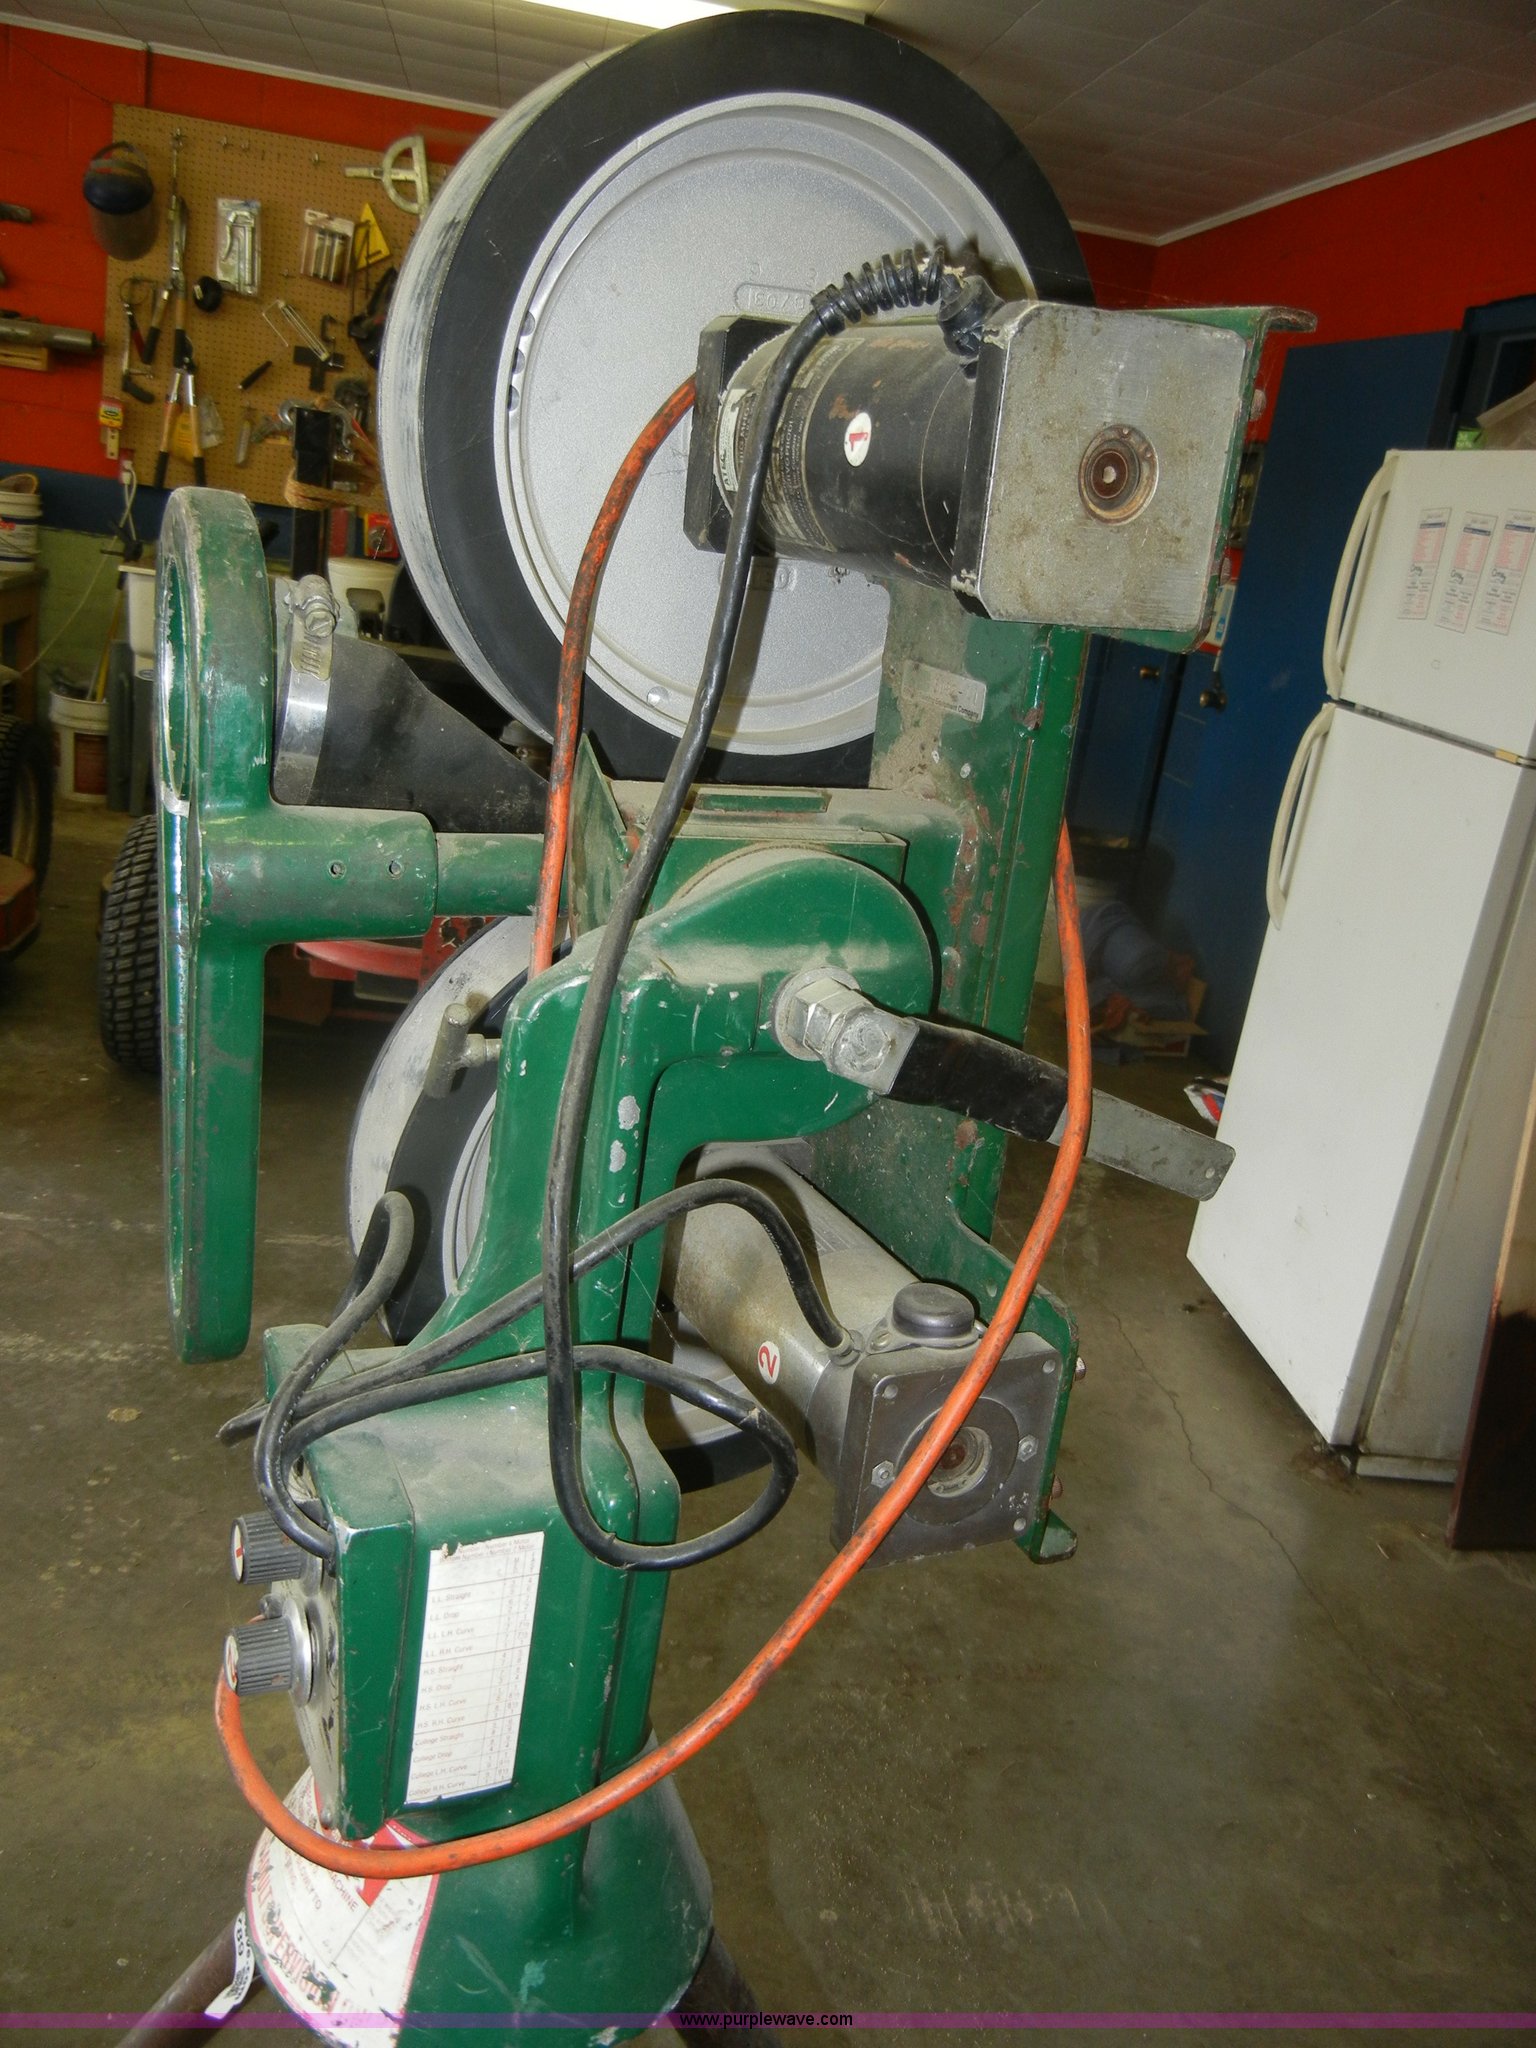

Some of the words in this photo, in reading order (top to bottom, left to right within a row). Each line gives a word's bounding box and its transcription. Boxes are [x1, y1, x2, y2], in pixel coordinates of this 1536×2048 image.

[759, 1345, 777, 1378] 2
[445, 1592, 471, 1602] Straight
[443, 1611, 460, 1620] Drop
[456, 1627, 475, 1635] Curve
[454, 1645, 474, 1653] Curve
[439, 1664, 463, 1673] Straight
[437, 1683, 452, 1691] Drop
[448, 1698, 467, 1706] Curve
[446, 1716, 465, 1724] Curve
[415, 1737, 438, 1747] College
[441, 1733, 464, 1742] Straight
[437, 1752, 452, 1760] Drop
[449, 1765, 468, 1774] Curve
[447, 1781, 466, 1789] Curve
